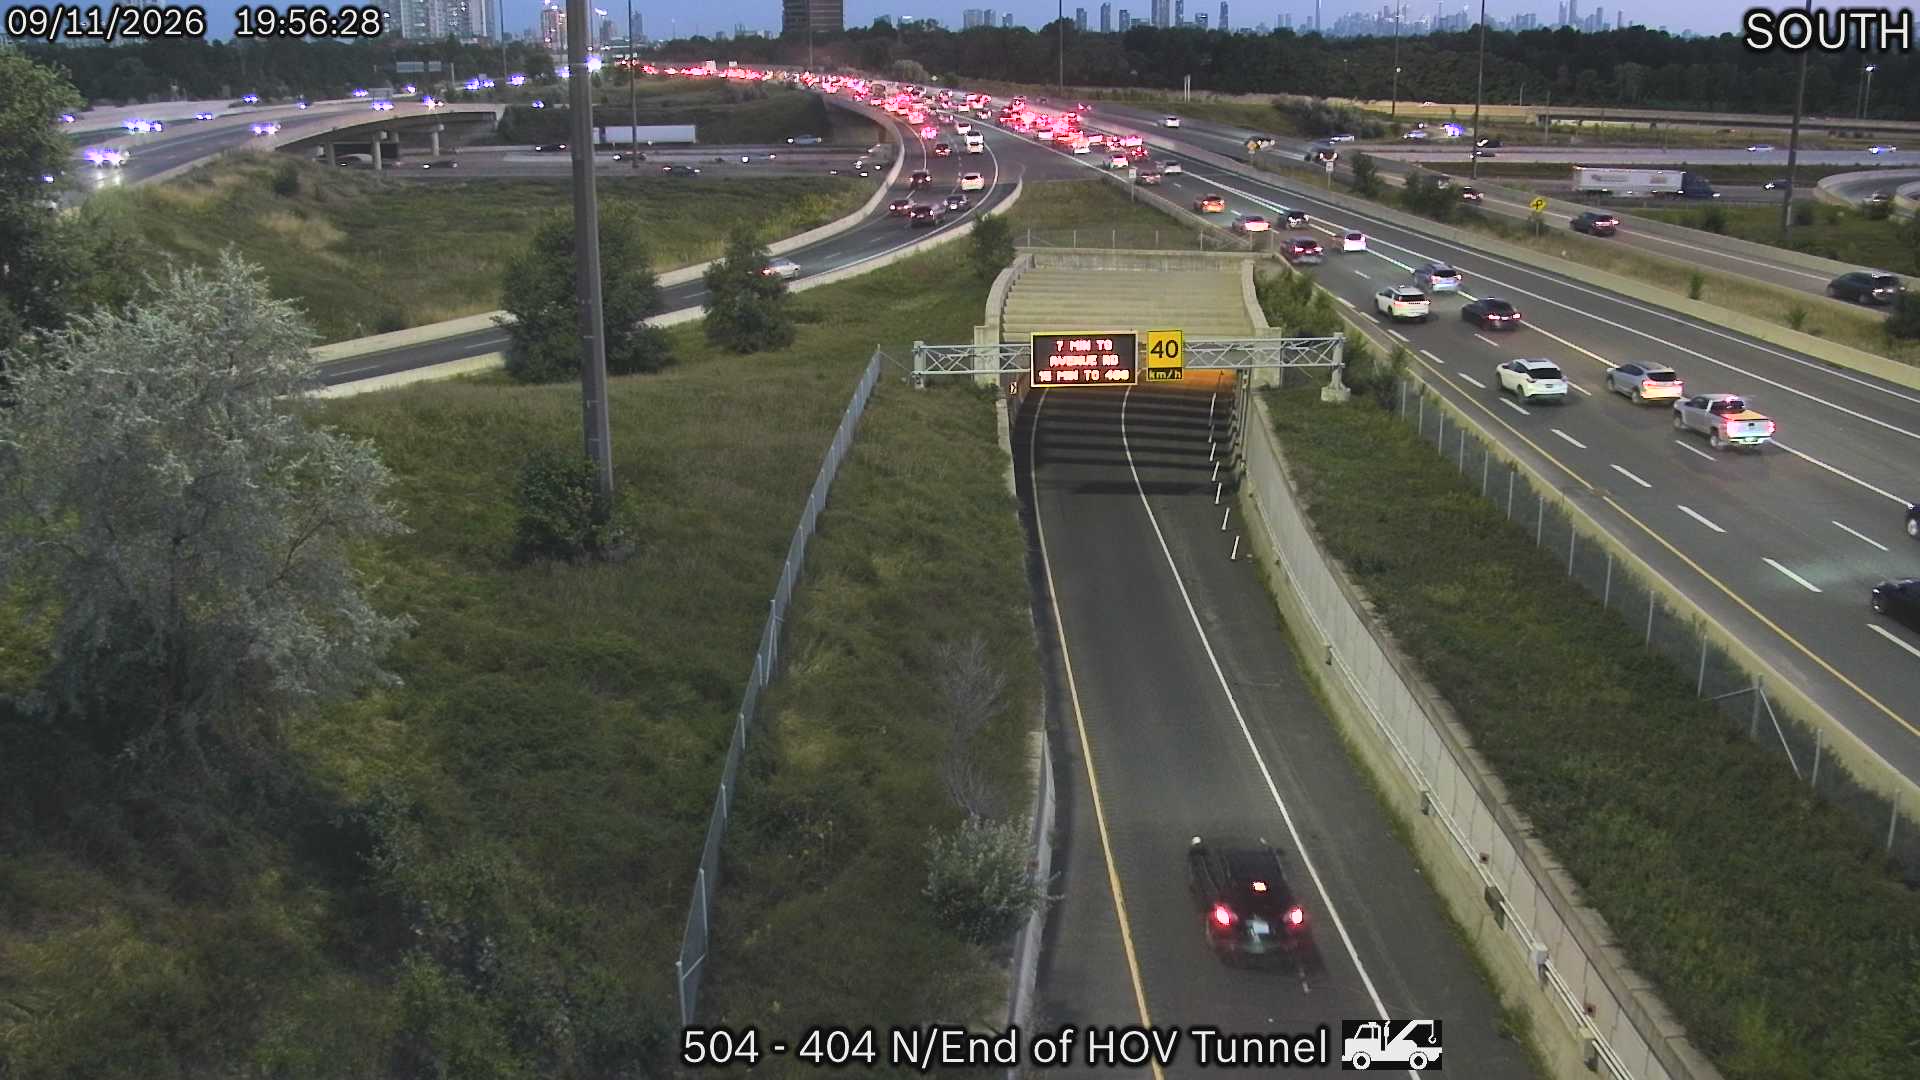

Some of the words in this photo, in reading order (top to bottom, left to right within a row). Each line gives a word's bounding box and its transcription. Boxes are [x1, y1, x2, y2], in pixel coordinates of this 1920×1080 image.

[1056, 340, 1064, 351] 7
[1069, 339, 1091, 351] MIN
[1096, 339, 1113, 351] TO
[1150, 339, 1179, 359] 40
[1049, 354, 1098, 366] AVENUE
[1056, 369, 1079, 381] MIN
[1083, 369, 1100, 381] TO
[1150, 369, 1182, 380] km/h
